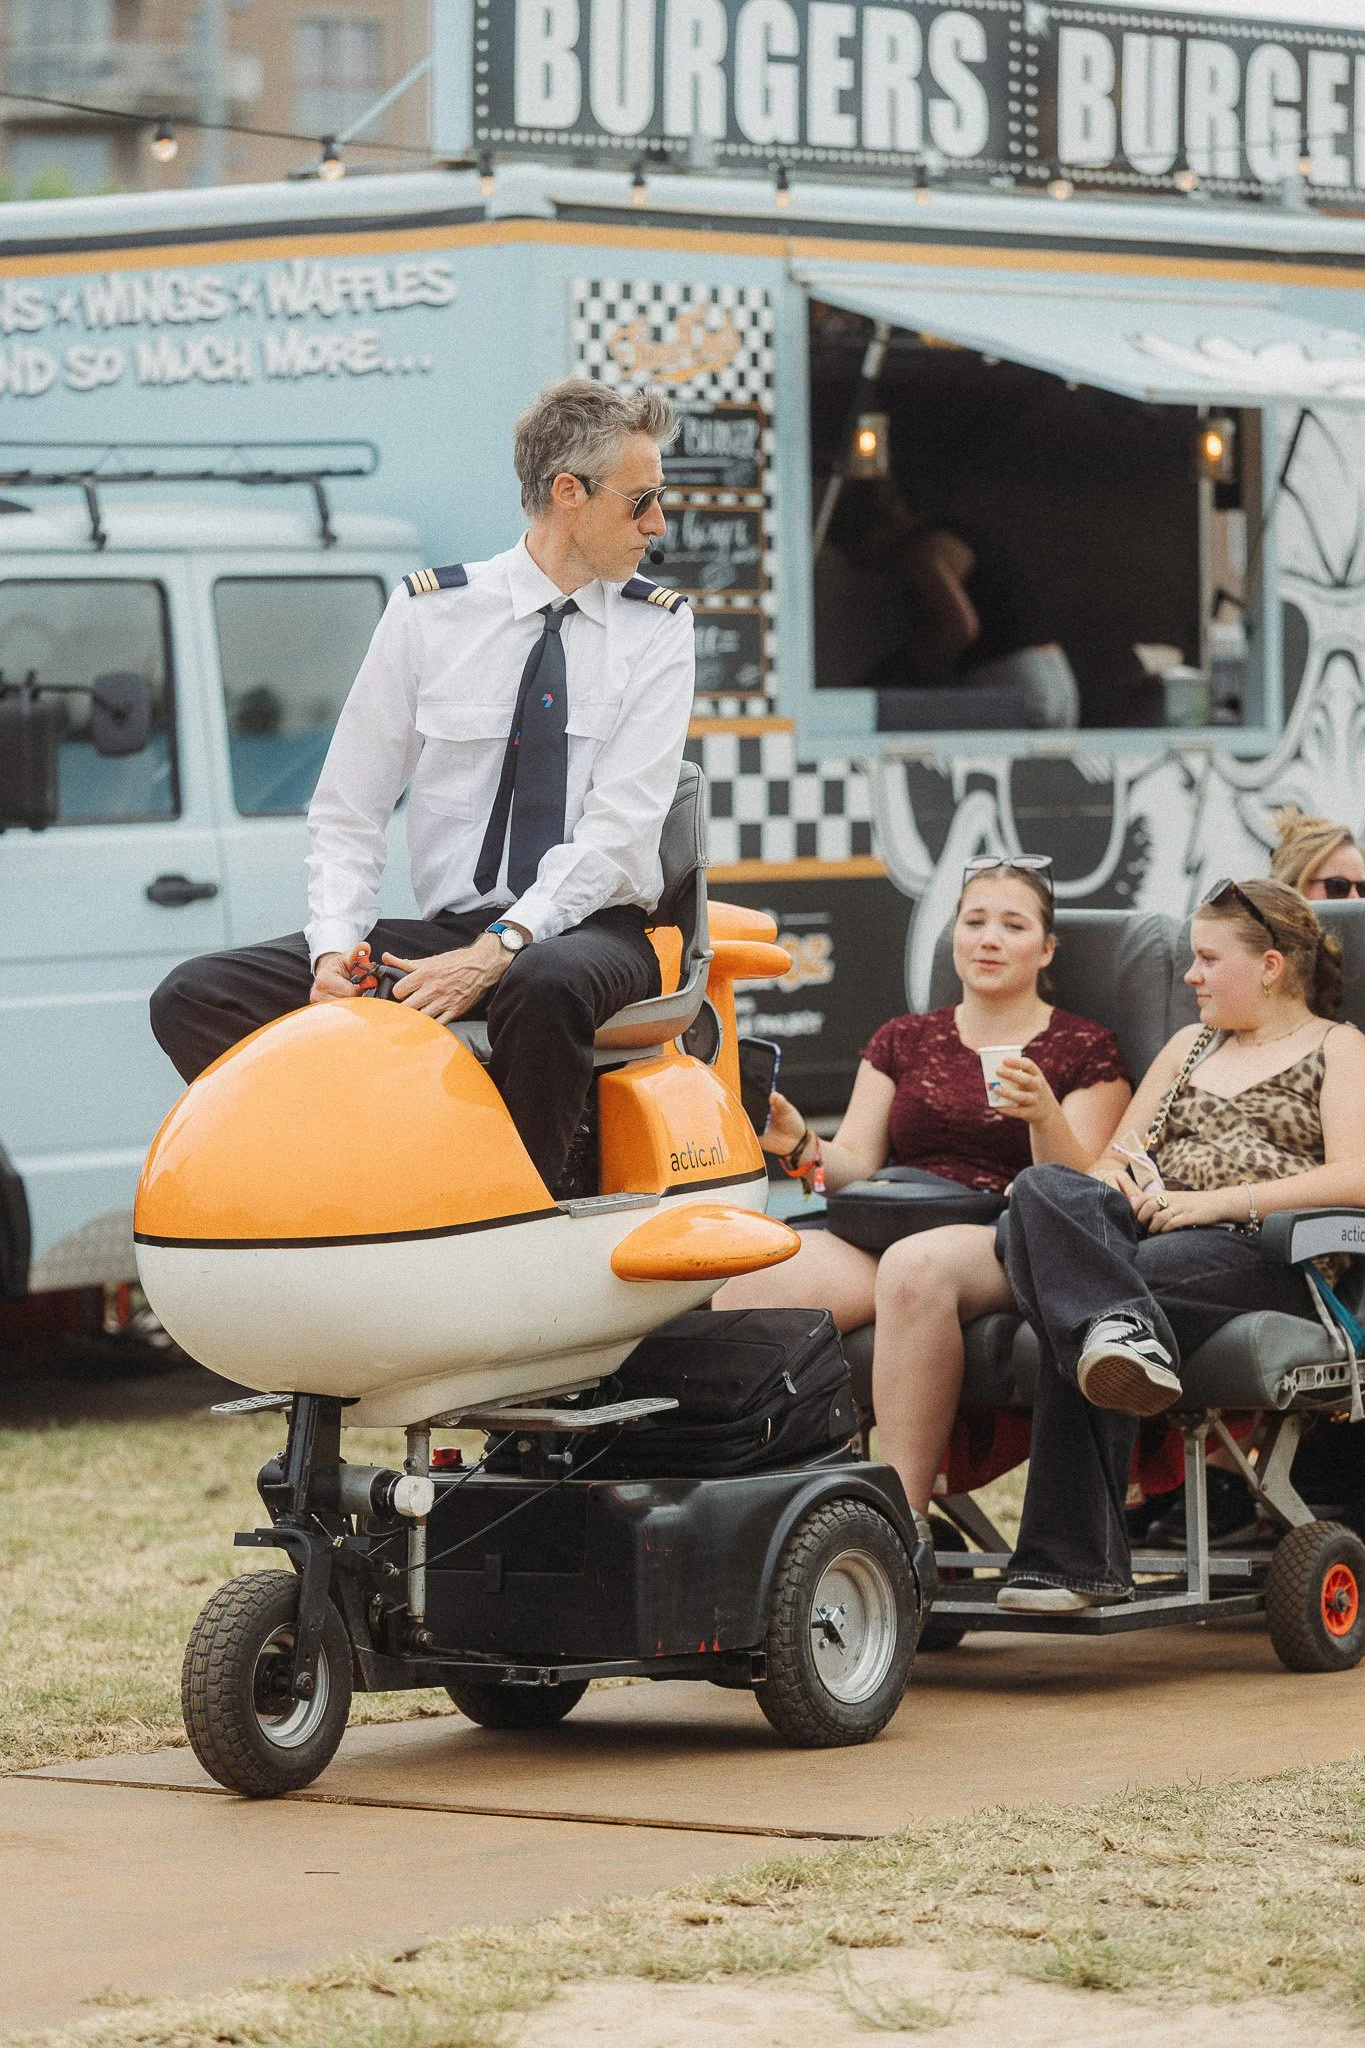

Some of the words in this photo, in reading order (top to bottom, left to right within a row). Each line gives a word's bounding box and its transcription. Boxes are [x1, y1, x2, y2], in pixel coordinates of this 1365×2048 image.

[514, 0, 990, 158] BURGERS
[1057, 26, 1365, 189] BURGE
[82, 270, 229, 328] WINGS
[266, 259, 457, 320] WAFFLES
[65, 343, 125, 391] SO
[135, 334, 252, 386] MUCH
[670, 1136, 725, 1172] actic.nl
